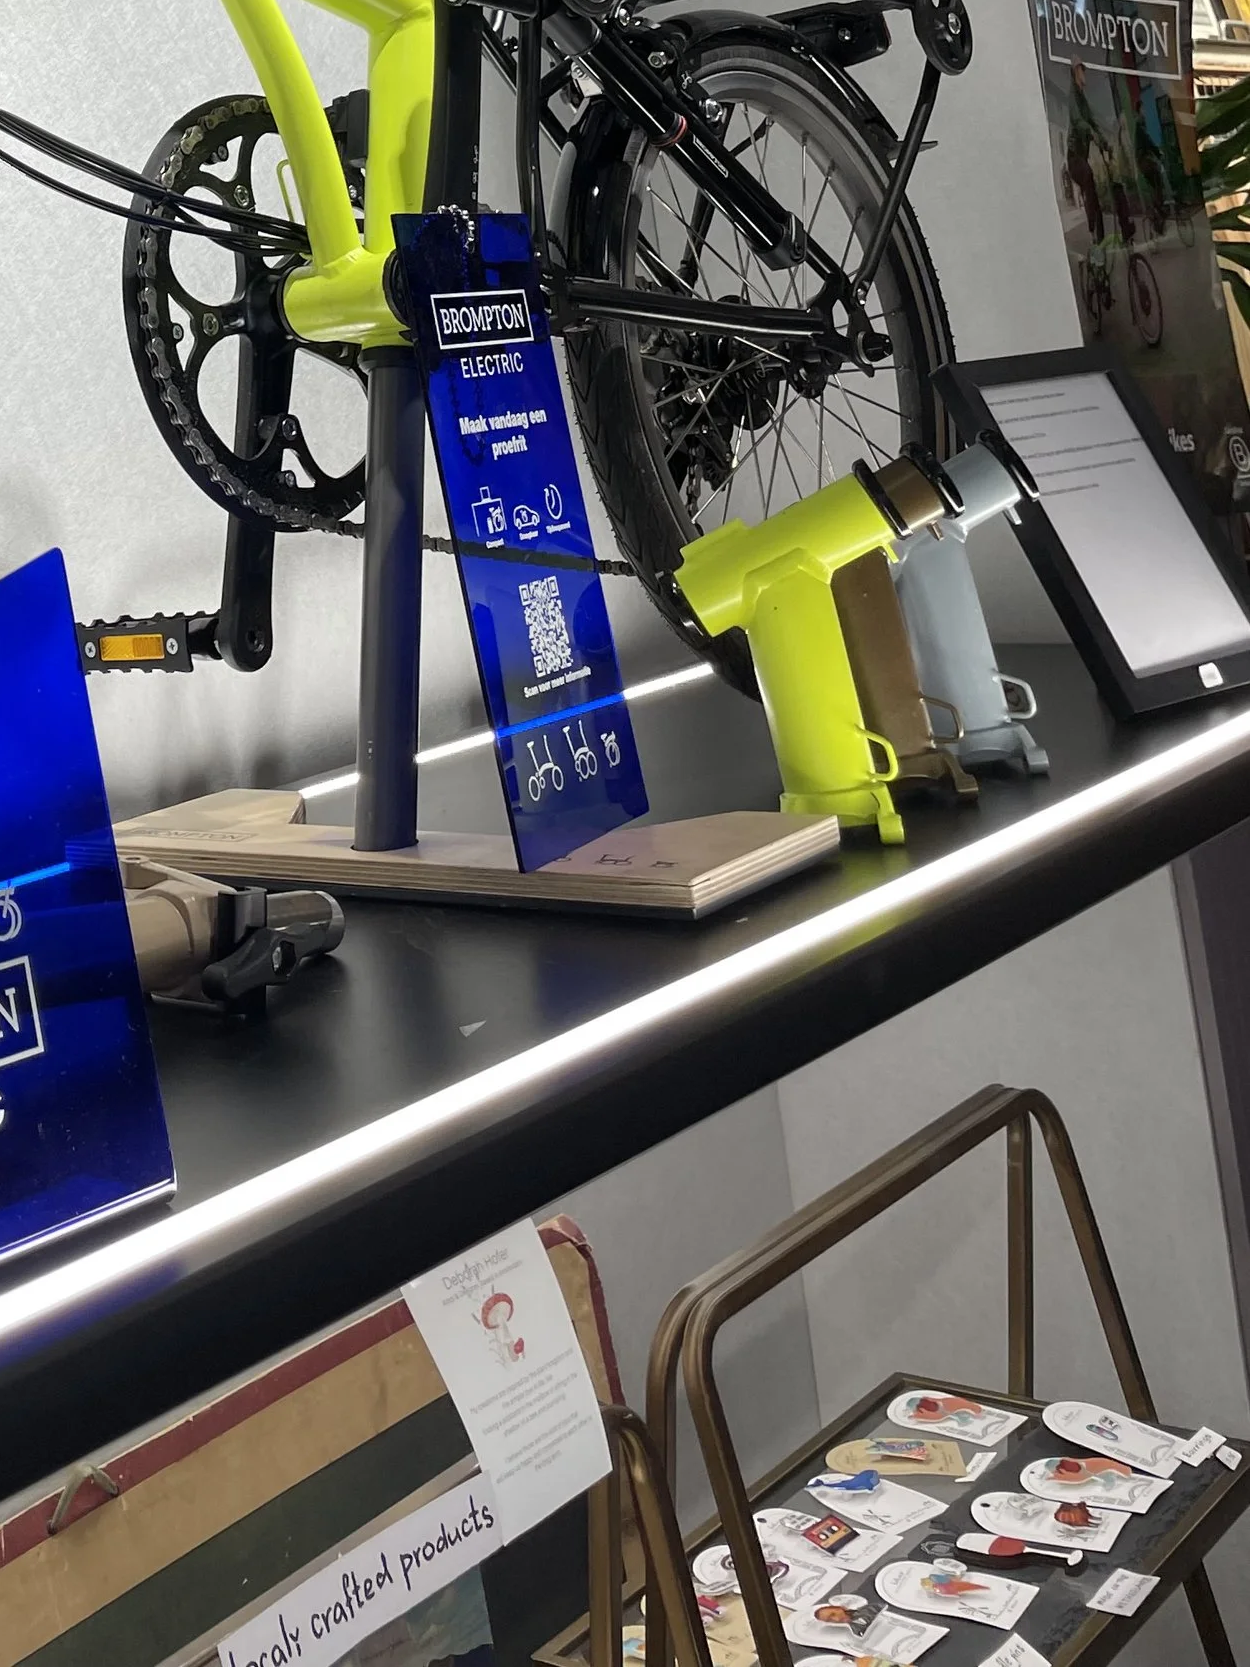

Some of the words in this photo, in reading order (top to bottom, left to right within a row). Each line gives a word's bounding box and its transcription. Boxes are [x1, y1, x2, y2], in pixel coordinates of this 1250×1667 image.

[1051, 0, 1169, 58] BROMPTON
[439, 303, 525, 335] BROMPTON
[460, 352, 524, 379] ELECTRIC
[458, 414, 489, 435] Maak
[488, 411, 530, 430] vandaag
[529, 409, 548, 424] een
[491, 434, 529, 461] proefrit
[310, 1551, 394, 1640] crafted
[400, 1494, 495, 1591] products
